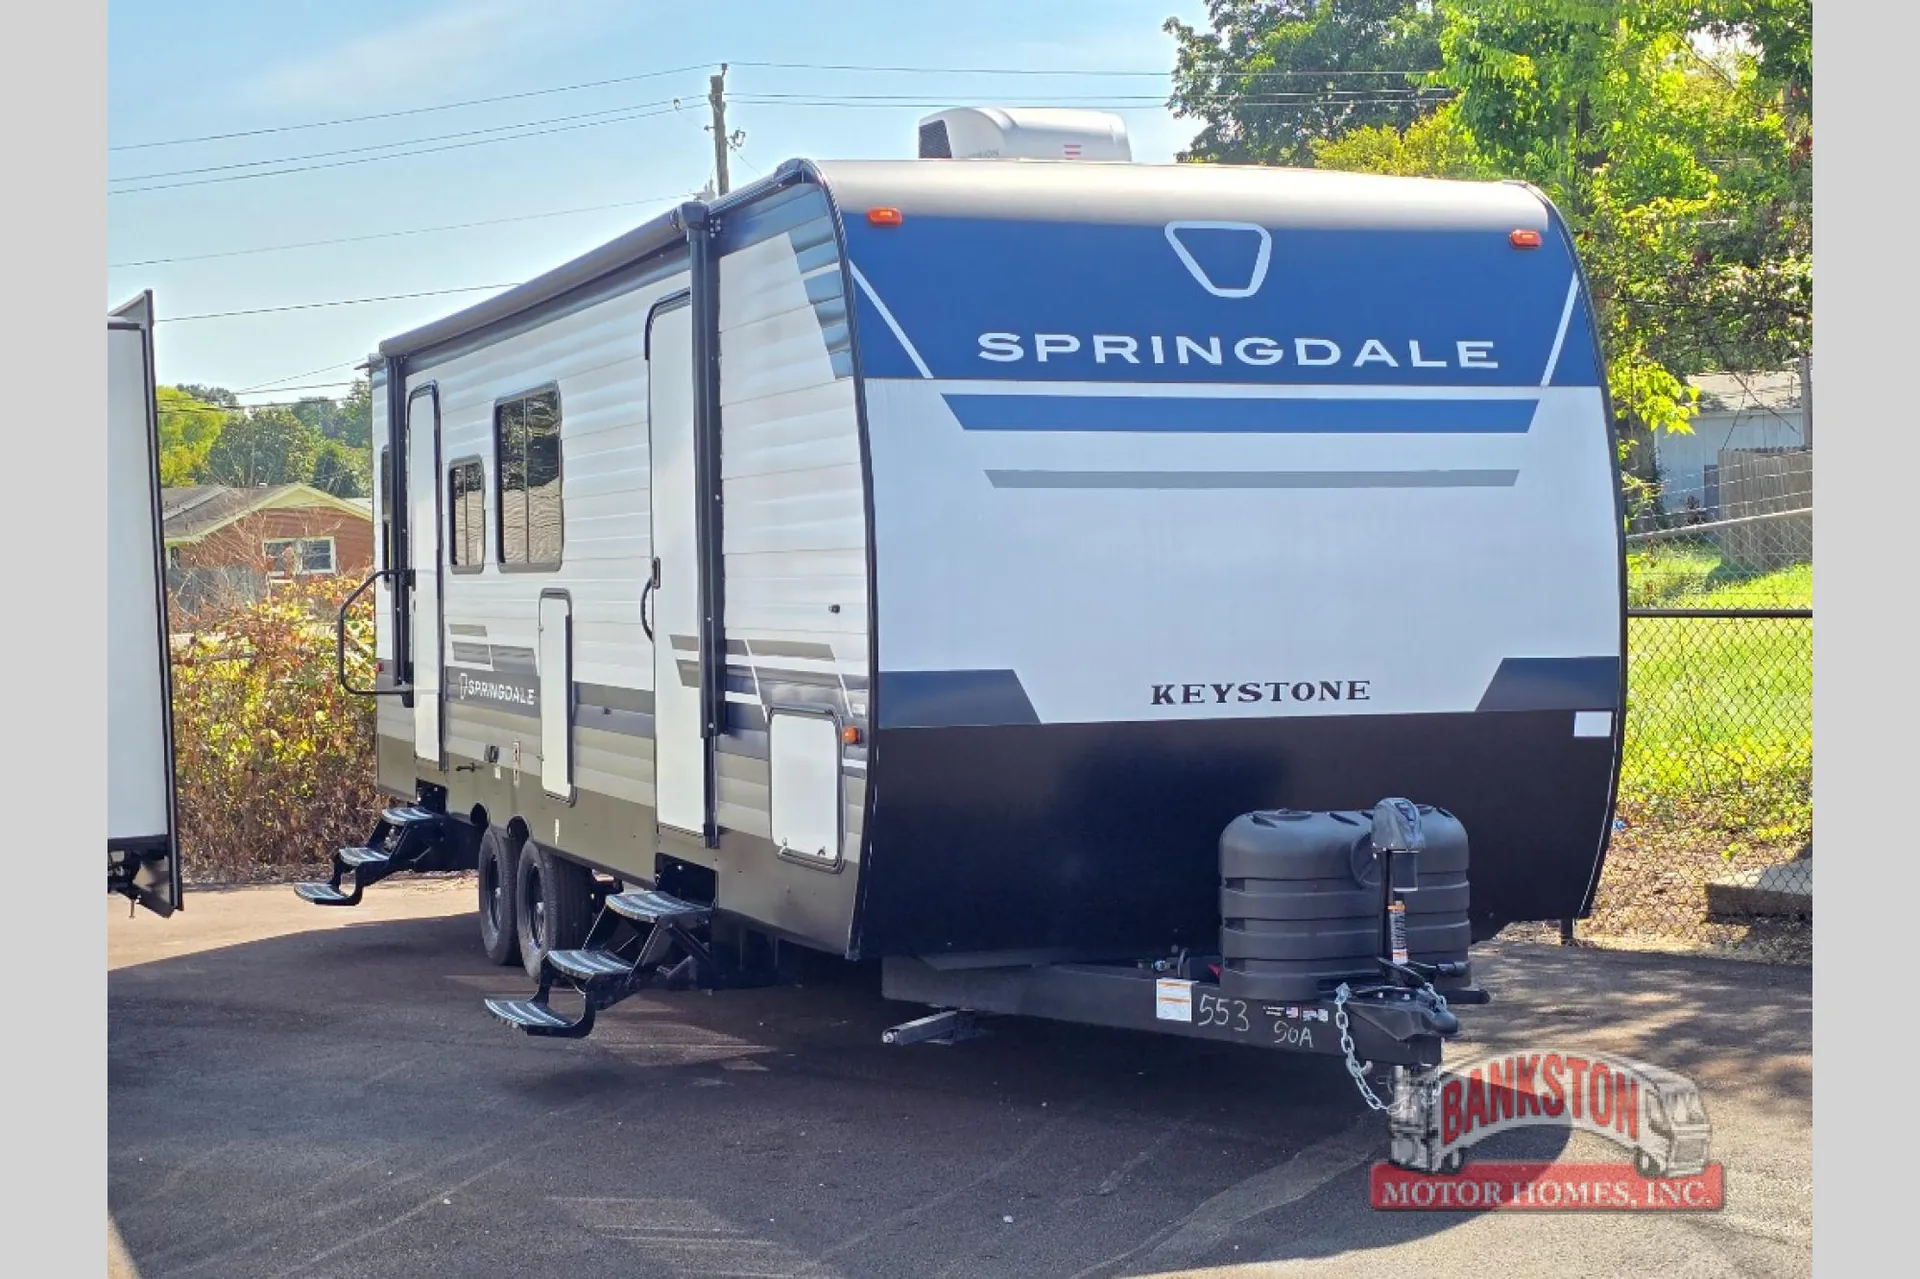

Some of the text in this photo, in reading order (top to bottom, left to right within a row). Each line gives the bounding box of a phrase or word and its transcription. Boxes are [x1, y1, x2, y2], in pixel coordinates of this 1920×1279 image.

[977, 332, 1499, 368] SPRINGDALE
[468, 680, 534, 705] SPRINGDALE
[1150, 680, 1371, 705] KEYSTONE
[1197, 993, 1249, 1032] 553
